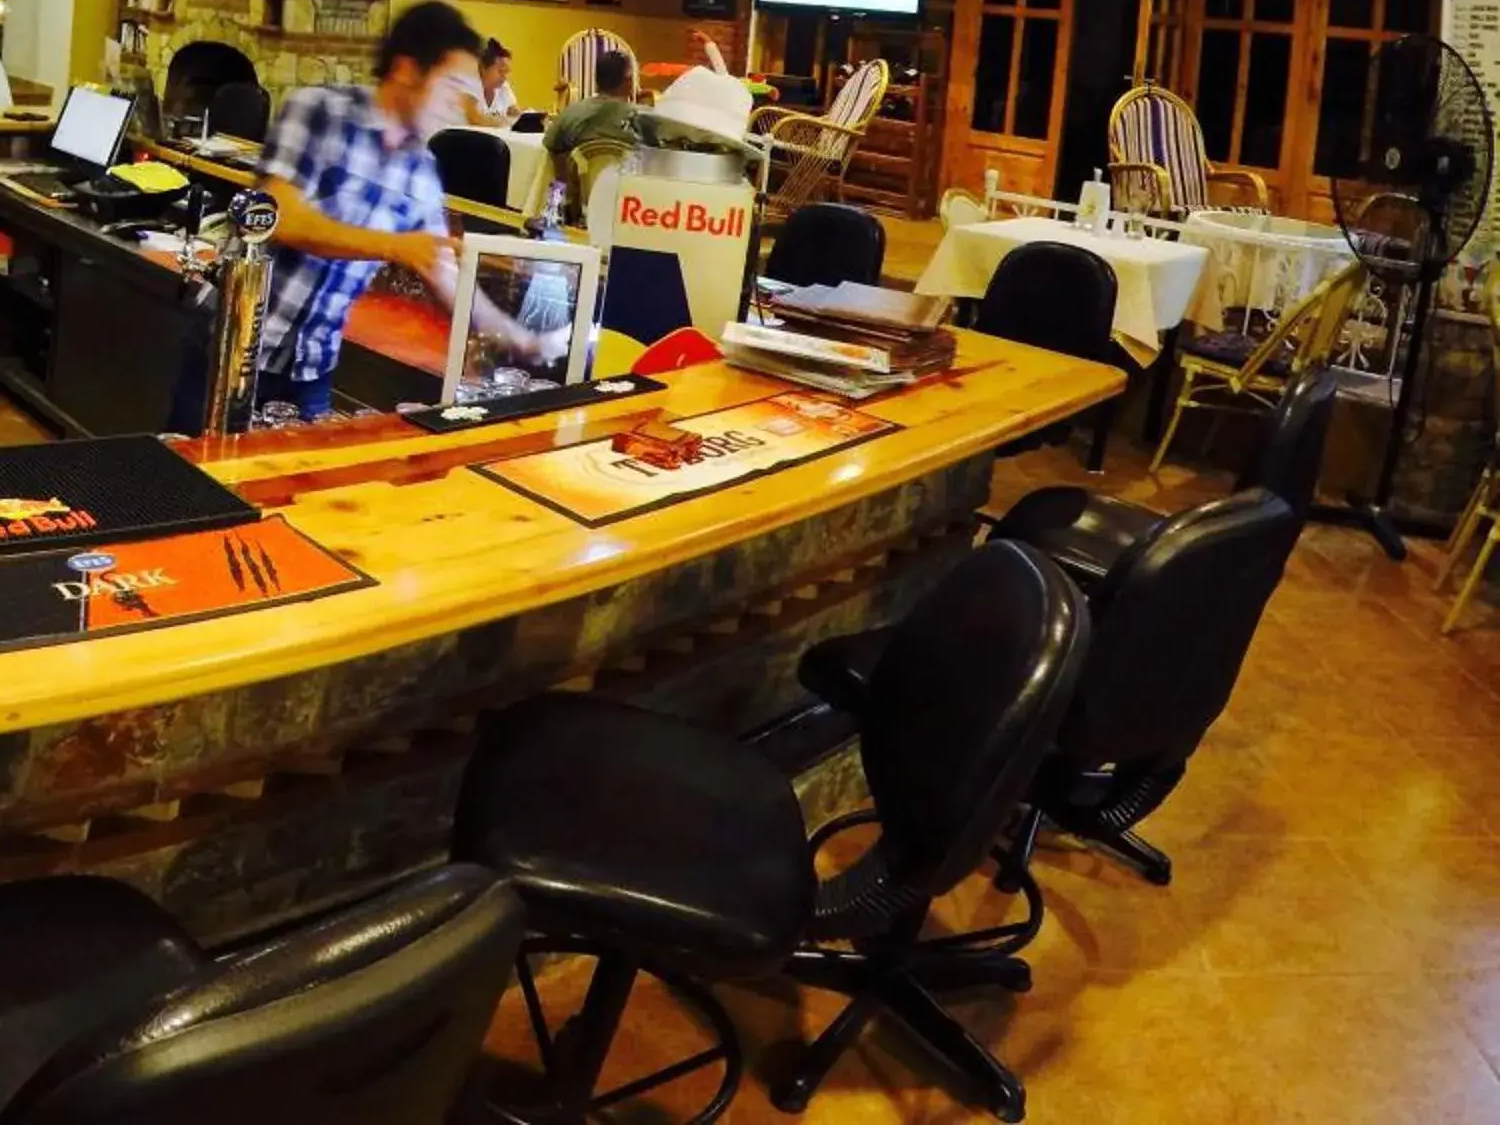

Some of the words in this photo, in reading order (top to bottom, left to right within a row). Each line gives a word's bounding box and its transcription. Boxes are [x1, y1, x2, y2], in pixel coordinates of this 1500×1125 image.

[621, 195, 681, 230] Red
[686, 204, 745, 238] Bull
[610, 430, 766, 478] TORG
[28, 509, 97, 535] Bull
[52, 568, 180, 600] DARK
